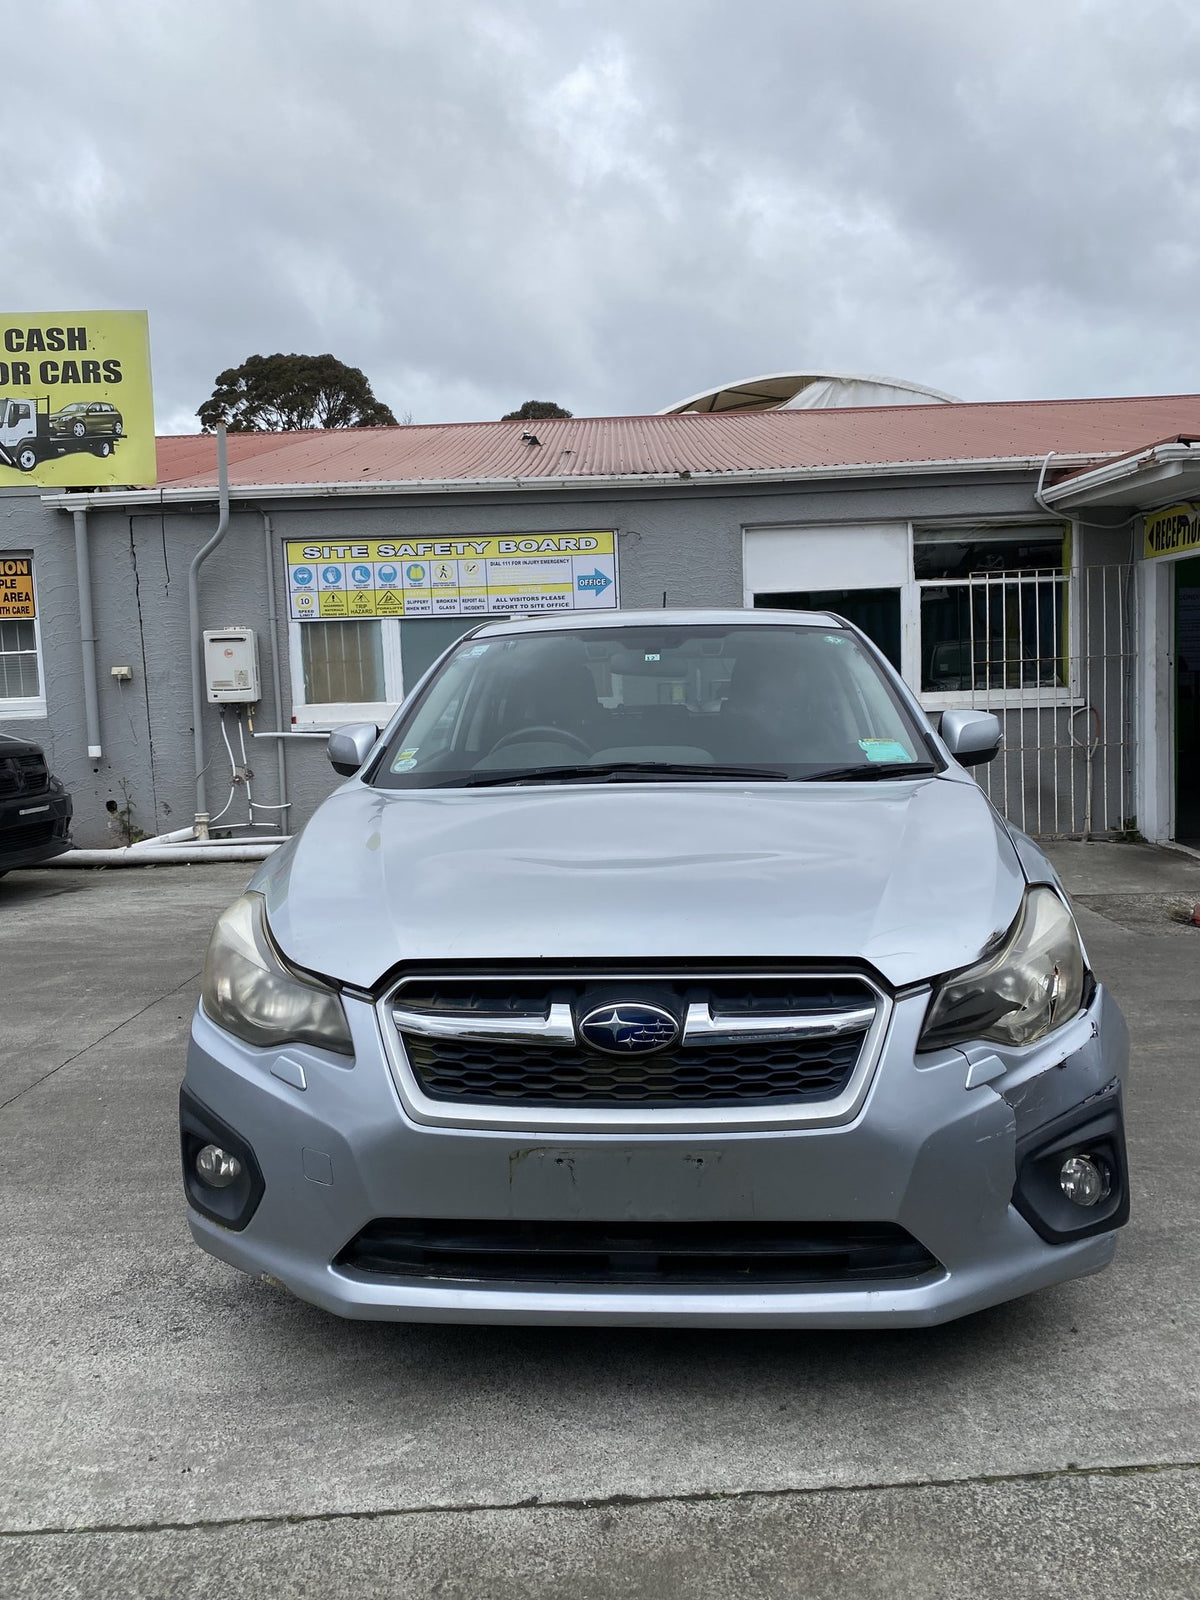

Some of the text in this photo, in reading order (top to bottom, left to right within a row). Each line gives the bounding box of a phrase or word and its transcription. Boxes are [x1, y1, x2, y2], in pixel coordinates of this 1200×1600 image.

[4, 327, 88, 353] CASH
[39, 359, 123, 385] CARS
[303, 537, 598, 559] SITE SAFETY BOARD
[579, 579, 607, 587] OFFICE
[3, 592, 31, 602] AREA
[300, 597, 310, 605] 10
[12, 606, 30, 614] CARE
